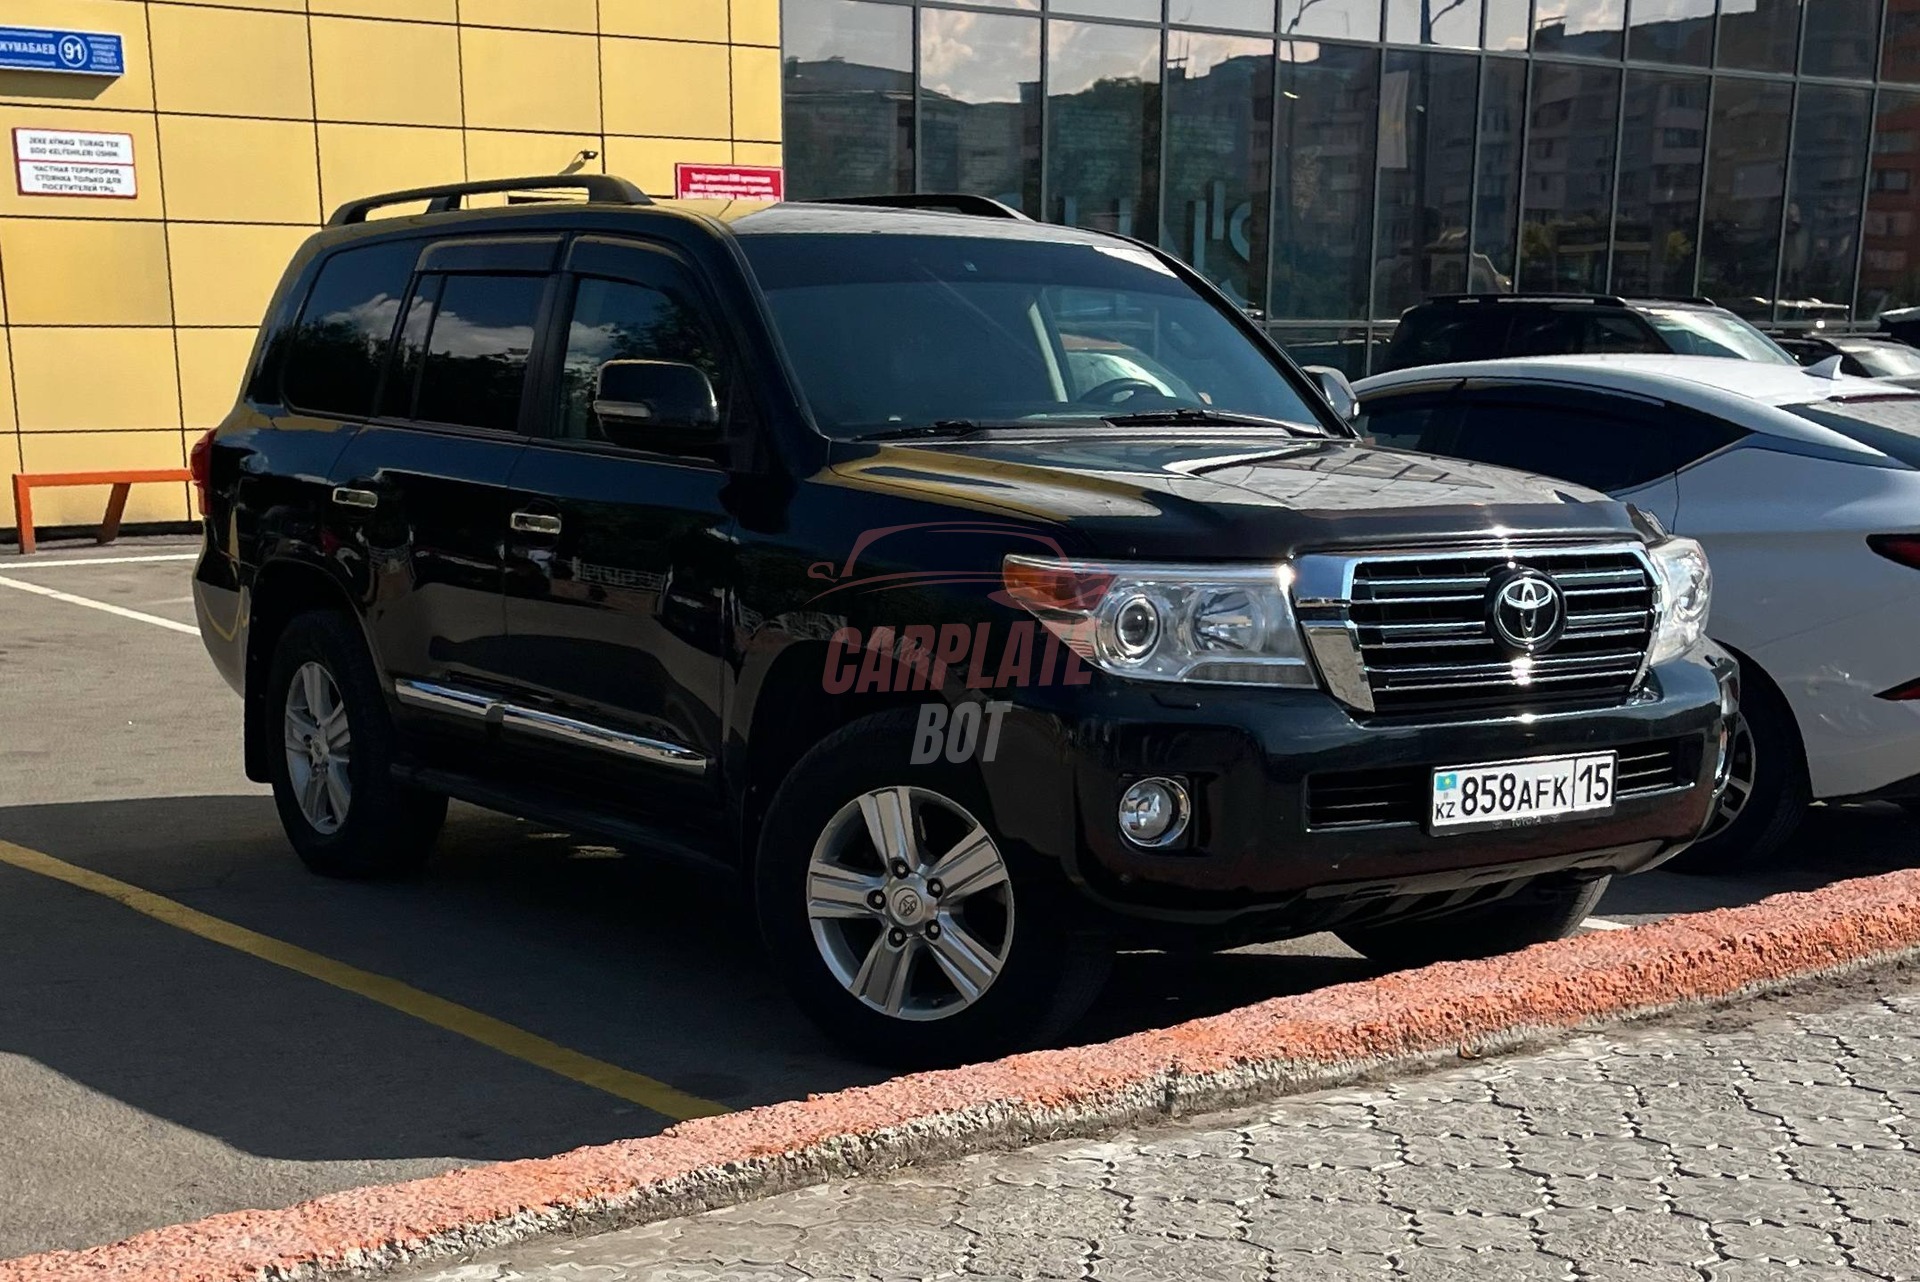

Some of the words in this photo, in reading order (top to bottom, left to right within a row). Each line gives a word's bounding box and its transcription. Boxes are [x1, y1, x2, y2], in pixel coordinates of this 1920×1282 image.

[63, 42, 82, 60] 91
[33, 165, 68, 173] ЧАСТНАЯ
[35, 174, 71, 182] СТОЯНКА
[74, 176, 104, 184] ТОЛЬКО
[42, 183, 97, 192] ПОСЕТИТЕЛЕЙ
[1435, 801, 1455, 820] KZ
[1579, 763, 1611, 802] 15
